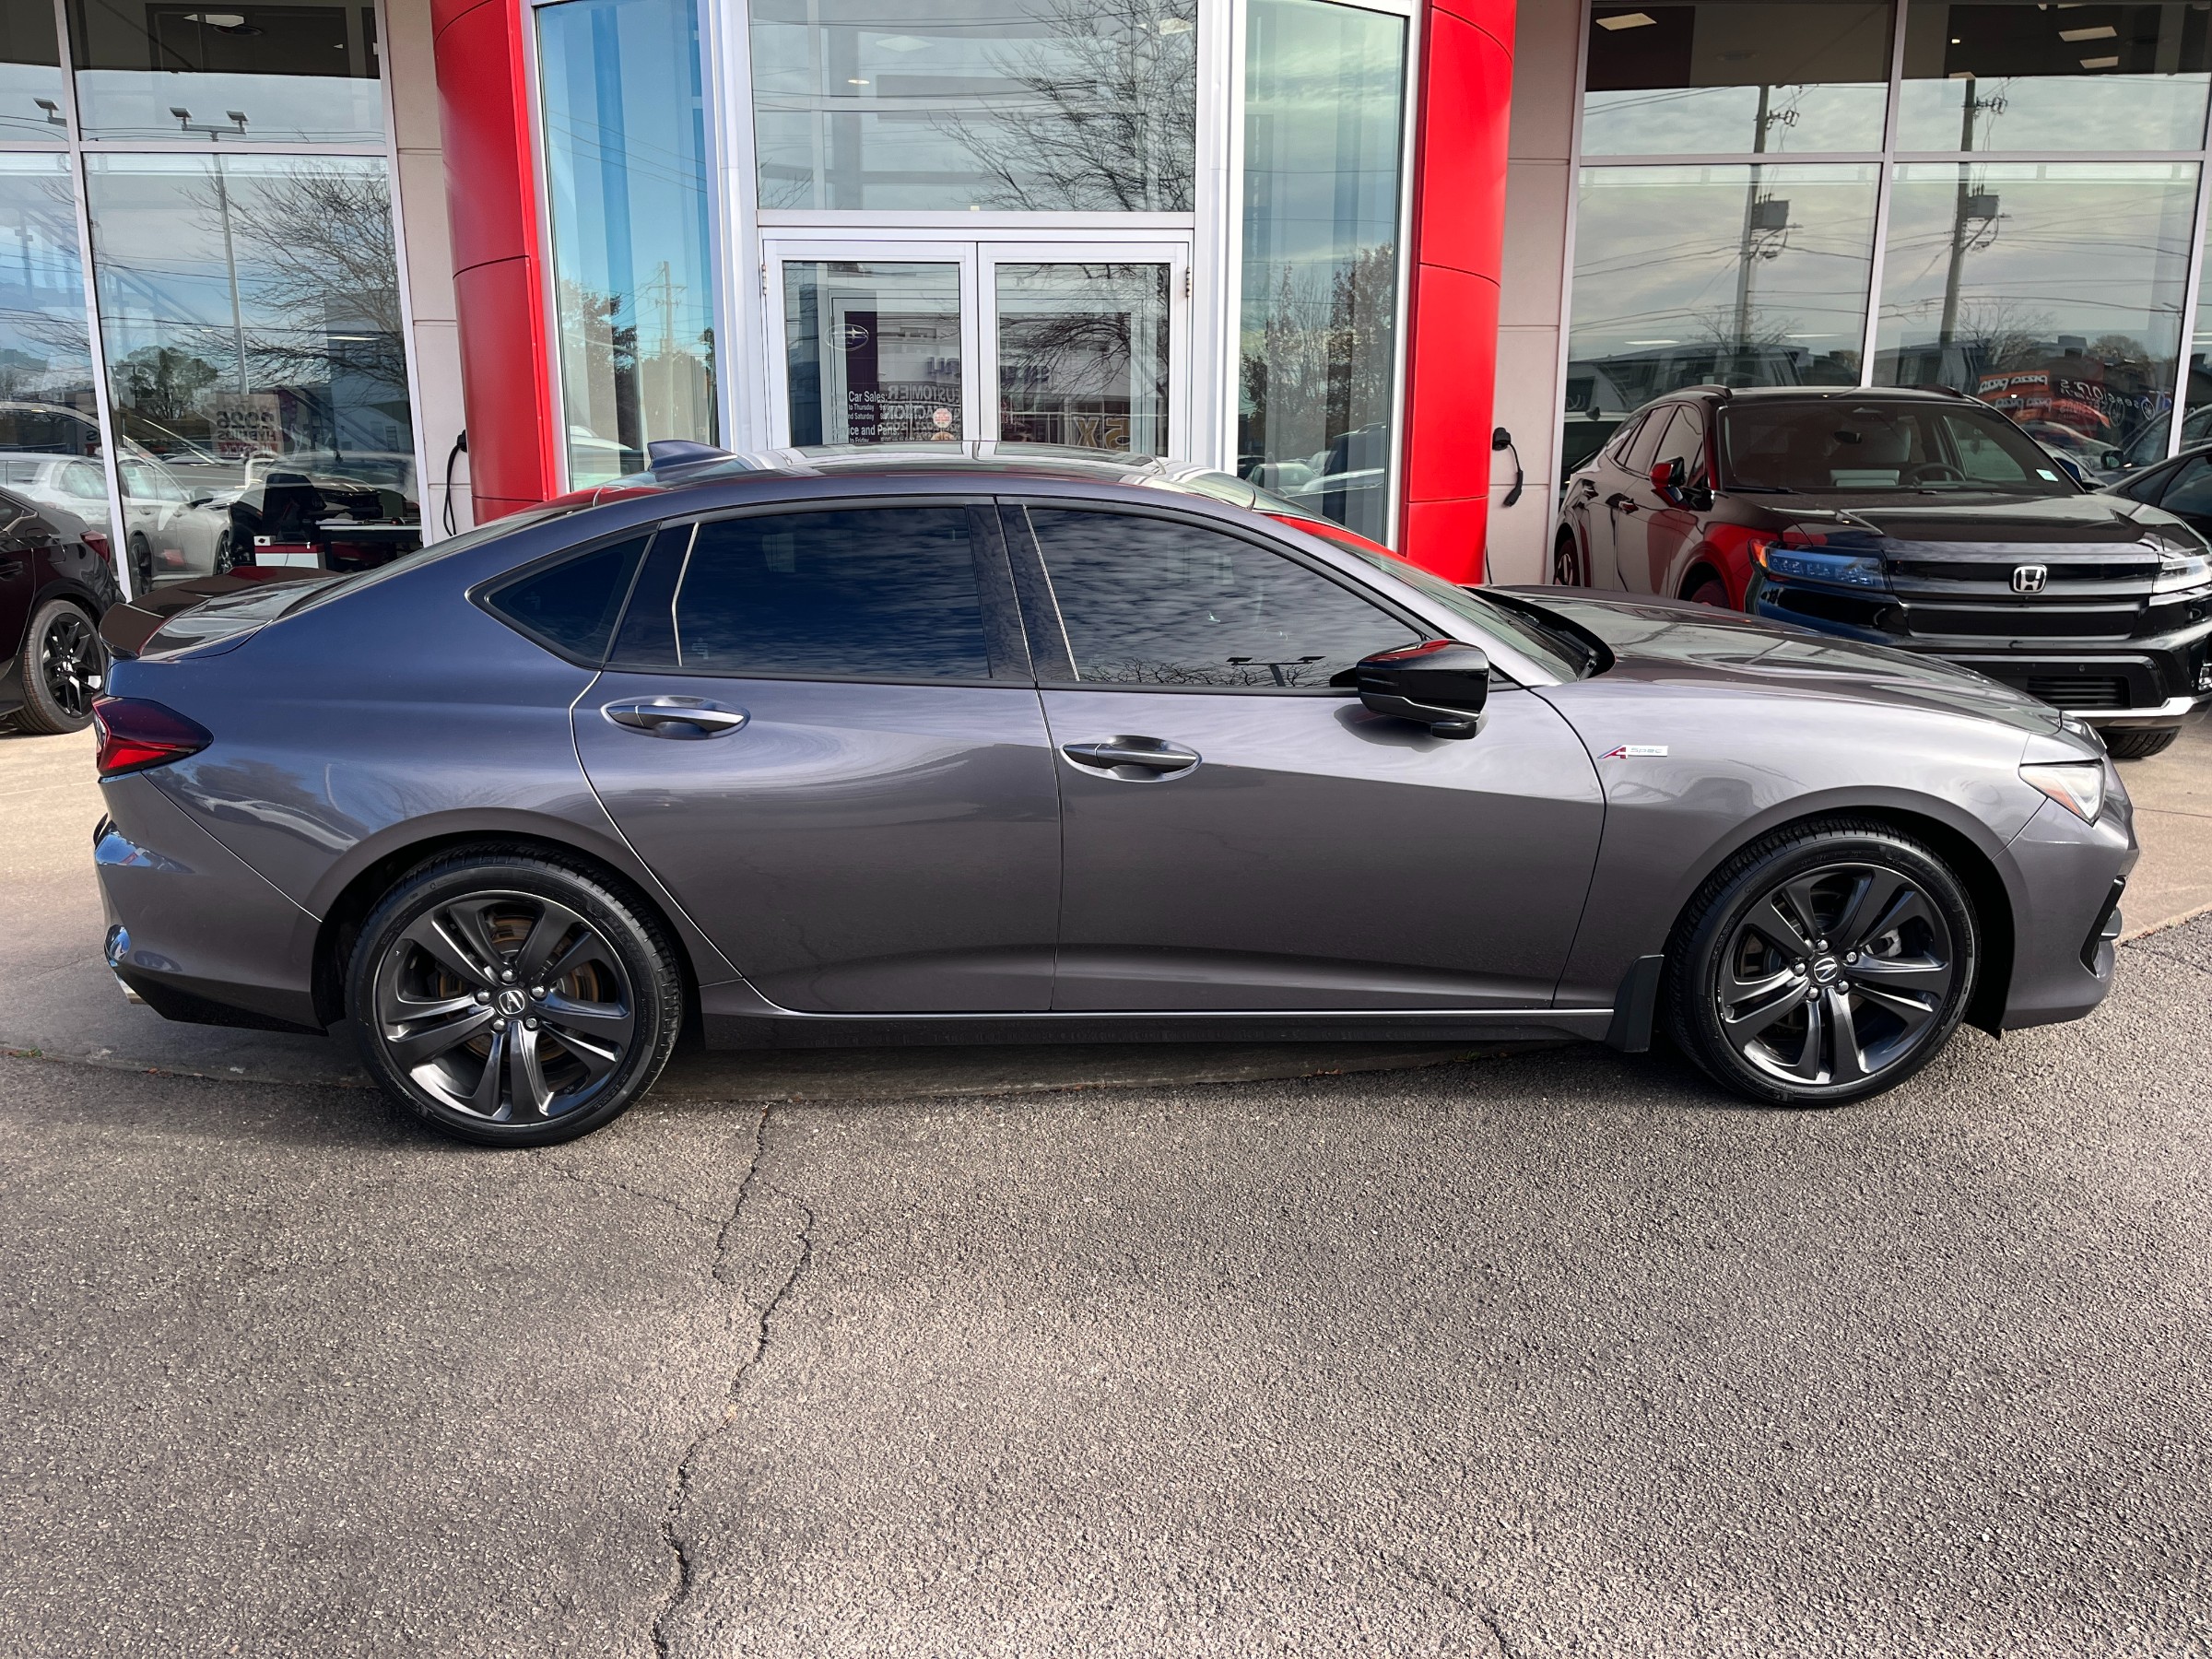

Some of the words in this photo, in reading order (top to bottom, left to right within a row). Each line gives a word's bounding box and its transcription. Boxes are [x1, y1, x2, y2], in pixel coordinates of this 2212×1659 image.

[848, 391, 862, 402] Car
[864, 391, 888, 403] Sales:
[853, 404, 875, 412] Thursday
[854, 413, 875, 421] Saturday
[861, 424, 876, 436] and
